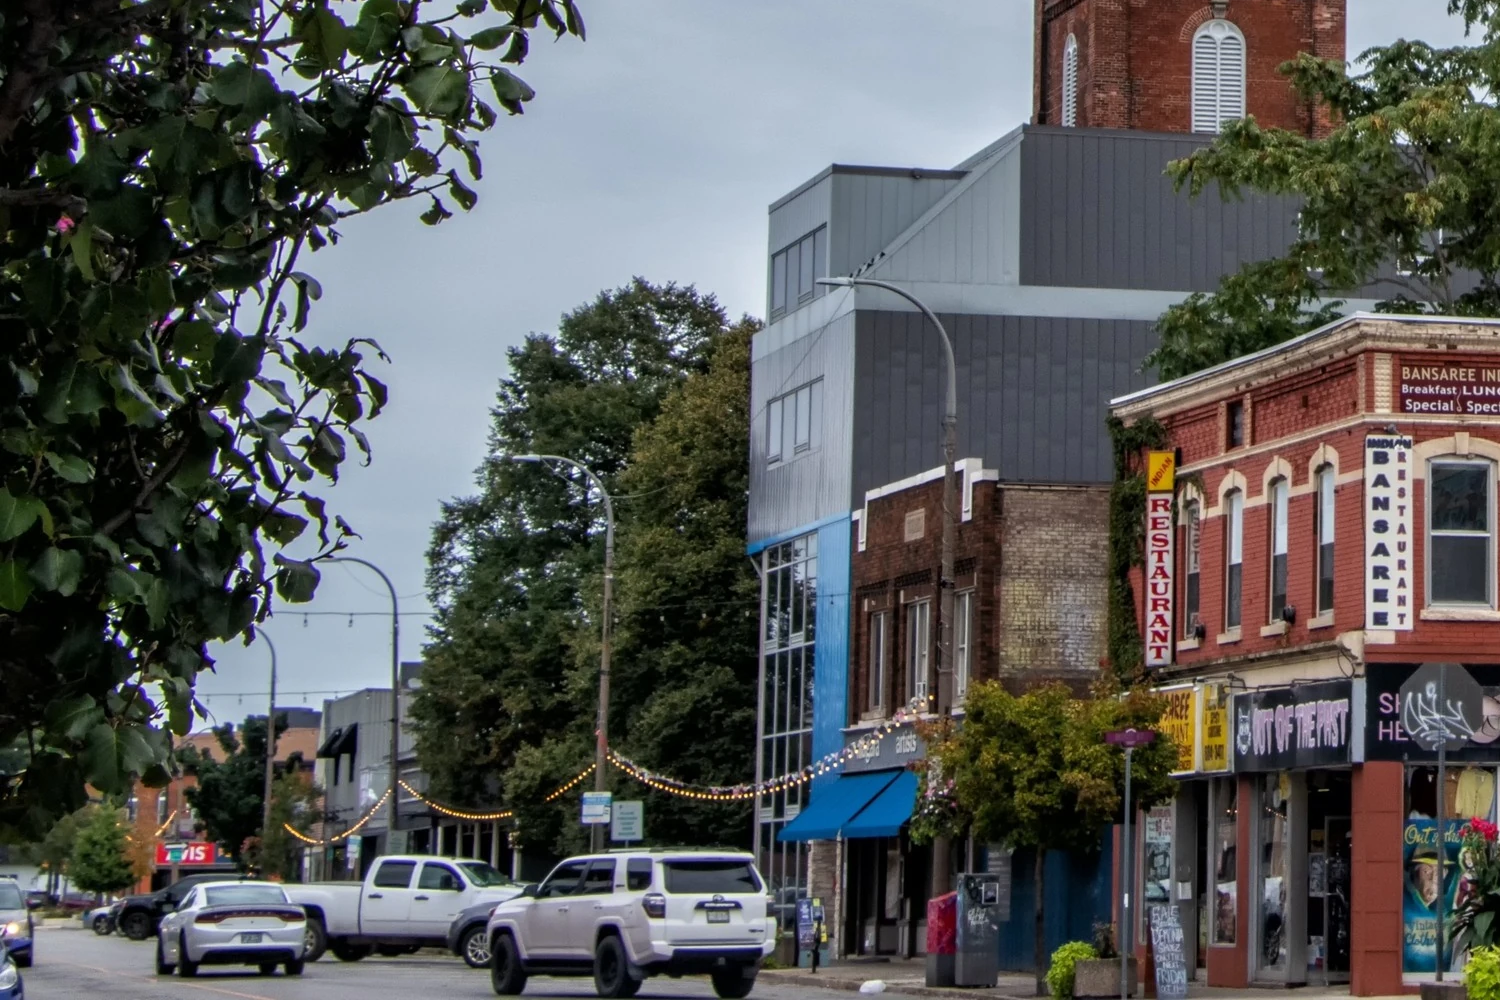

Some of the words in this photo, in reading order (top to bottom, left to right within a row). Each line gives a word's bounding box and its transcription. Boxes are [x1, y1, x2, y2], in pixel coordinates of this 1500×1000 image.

[1402, 366, 1476, 382] BANSAREE
[1402, 384, 1457, 395] Breakfast
[1405, 399, 1454, 413] Special
[1367, 438, 1412, 449] INDIAN
[1151, 456, 1173, 487] INDIAN
[1371, 450, 1391, 626] BANSAREE
[1397, 451, 1407, 625] RESTAURANT
[1149, 498, 1171, 659] RESTAURANT
[1252, 707, 1274, 755] OUT
[1275, 704, 1294, 753] OF
[1295, 701, 1316, 749] THE
[1316, 698, 1349, 748] PAST
